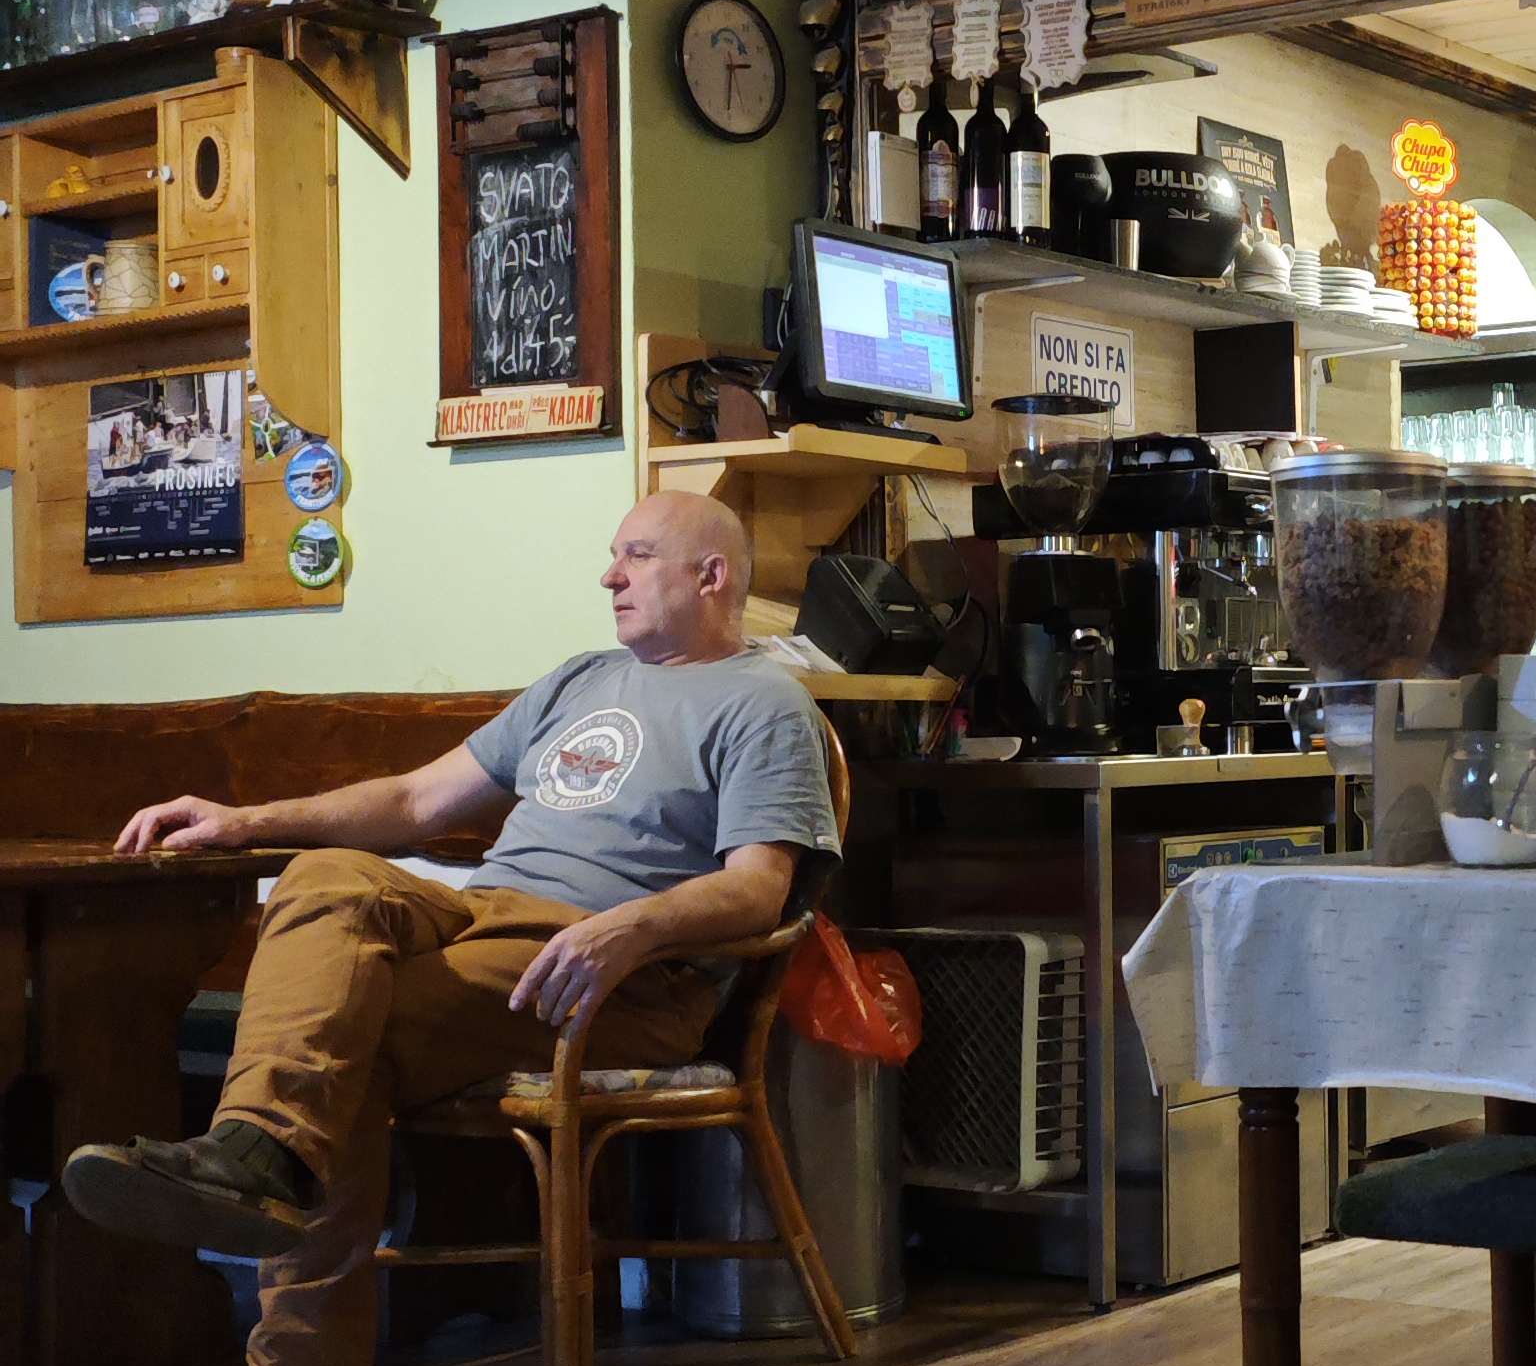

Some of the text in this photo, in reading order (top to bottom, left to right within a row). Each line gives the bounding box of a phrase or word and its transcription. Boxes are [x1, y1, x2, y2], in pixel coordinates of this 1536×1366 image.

[1401, 138, 1446, 160] Chupa
[1401, 155, 1445, 180] Chups
[1040, 333, 1126, 374] NON SI FA
[1045, 370, 1121, 406] CREDITO
[441, 399, 507, 436] KLÁŠTEREC
[548, 388, 595, 426] KADAŇ
[155, 463, 235, 492] PROSINEC
